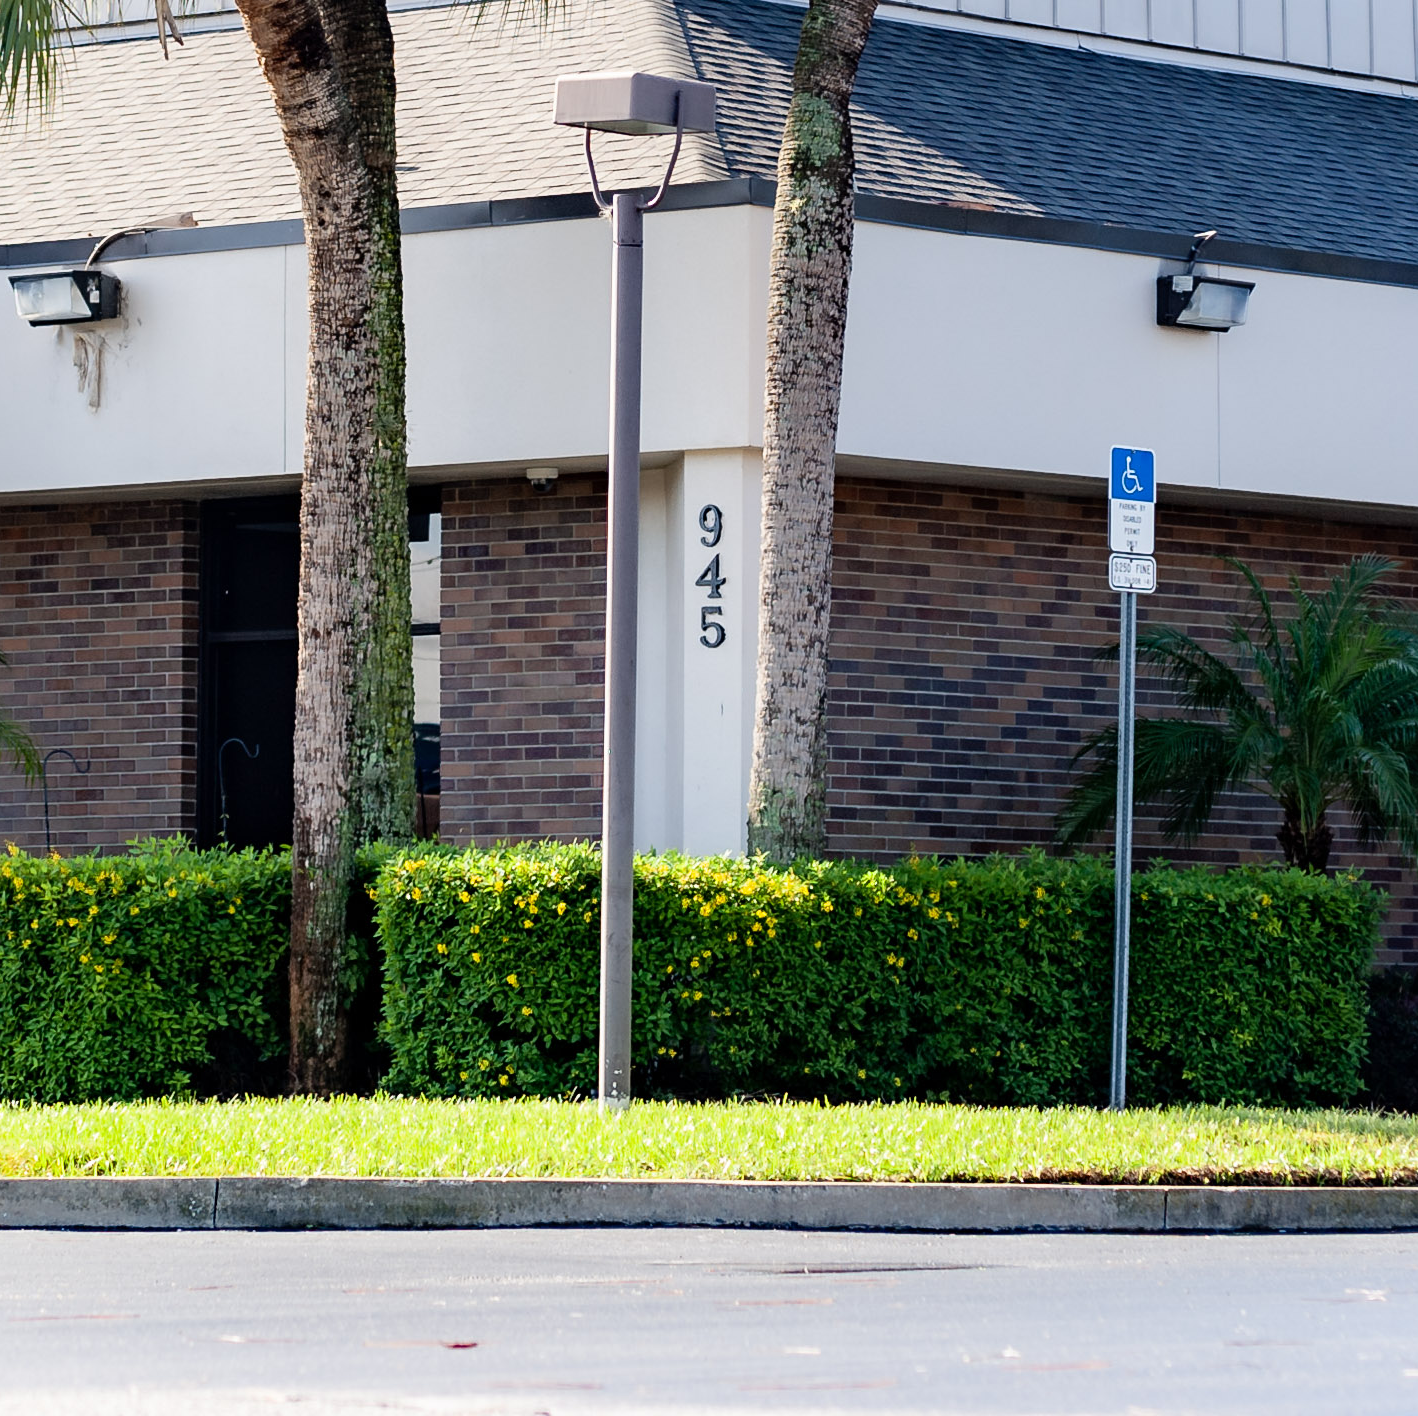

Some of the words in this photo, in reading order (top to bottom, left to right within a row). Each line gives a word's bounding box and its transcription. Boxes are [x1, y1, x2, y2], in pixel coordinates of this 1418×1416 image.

[1119, 502, 1137, 511] PARKING
[1114, 561, 1132, 573] $250
[1135, 564, 1151, 575] FINE
